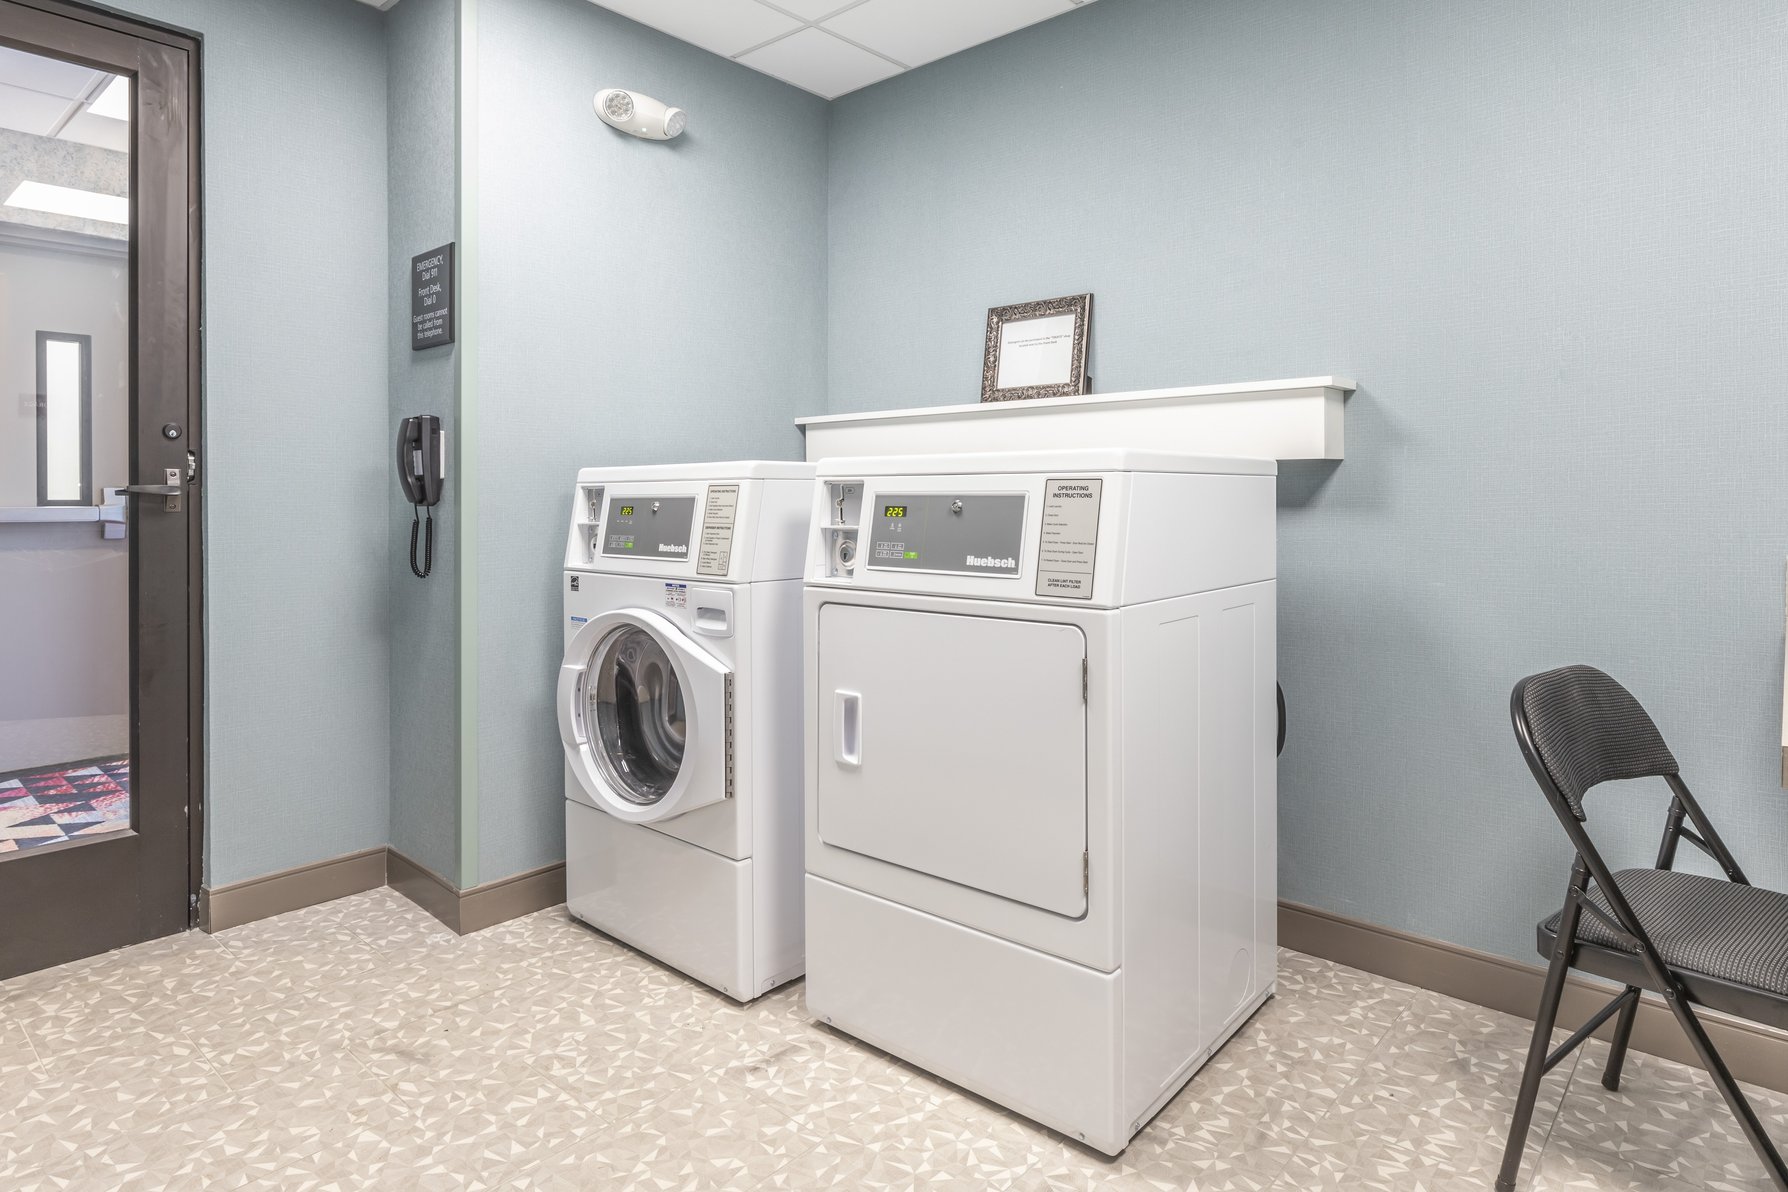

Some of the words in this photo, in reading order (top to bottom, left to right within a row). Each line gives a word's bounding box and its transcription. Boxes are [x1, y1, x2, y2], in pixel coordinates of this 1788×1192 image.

[416, 254, 444, 272] EMERGENCY,
[422, 270, 430, 280] Dial
[418, 286, 430, 296] Front
[430, 282, 442, 293] Desk,
[424, 295, 432, 306] Dial
[433, 294, 436, 303] 0
[413, 314, 423, 322] Guest
[424, 311, 434, 320] rooms
[435, 308, 448, 317] cannot
[418, 322, 423, 330] be
[423, 320, 433, 329] called
[434, 318, 442, 326] from
[886, 507, 903, 517] 225
[658, 544, 687, 552] Huebsch
[966, 555, 1016, 568] Huebsch
